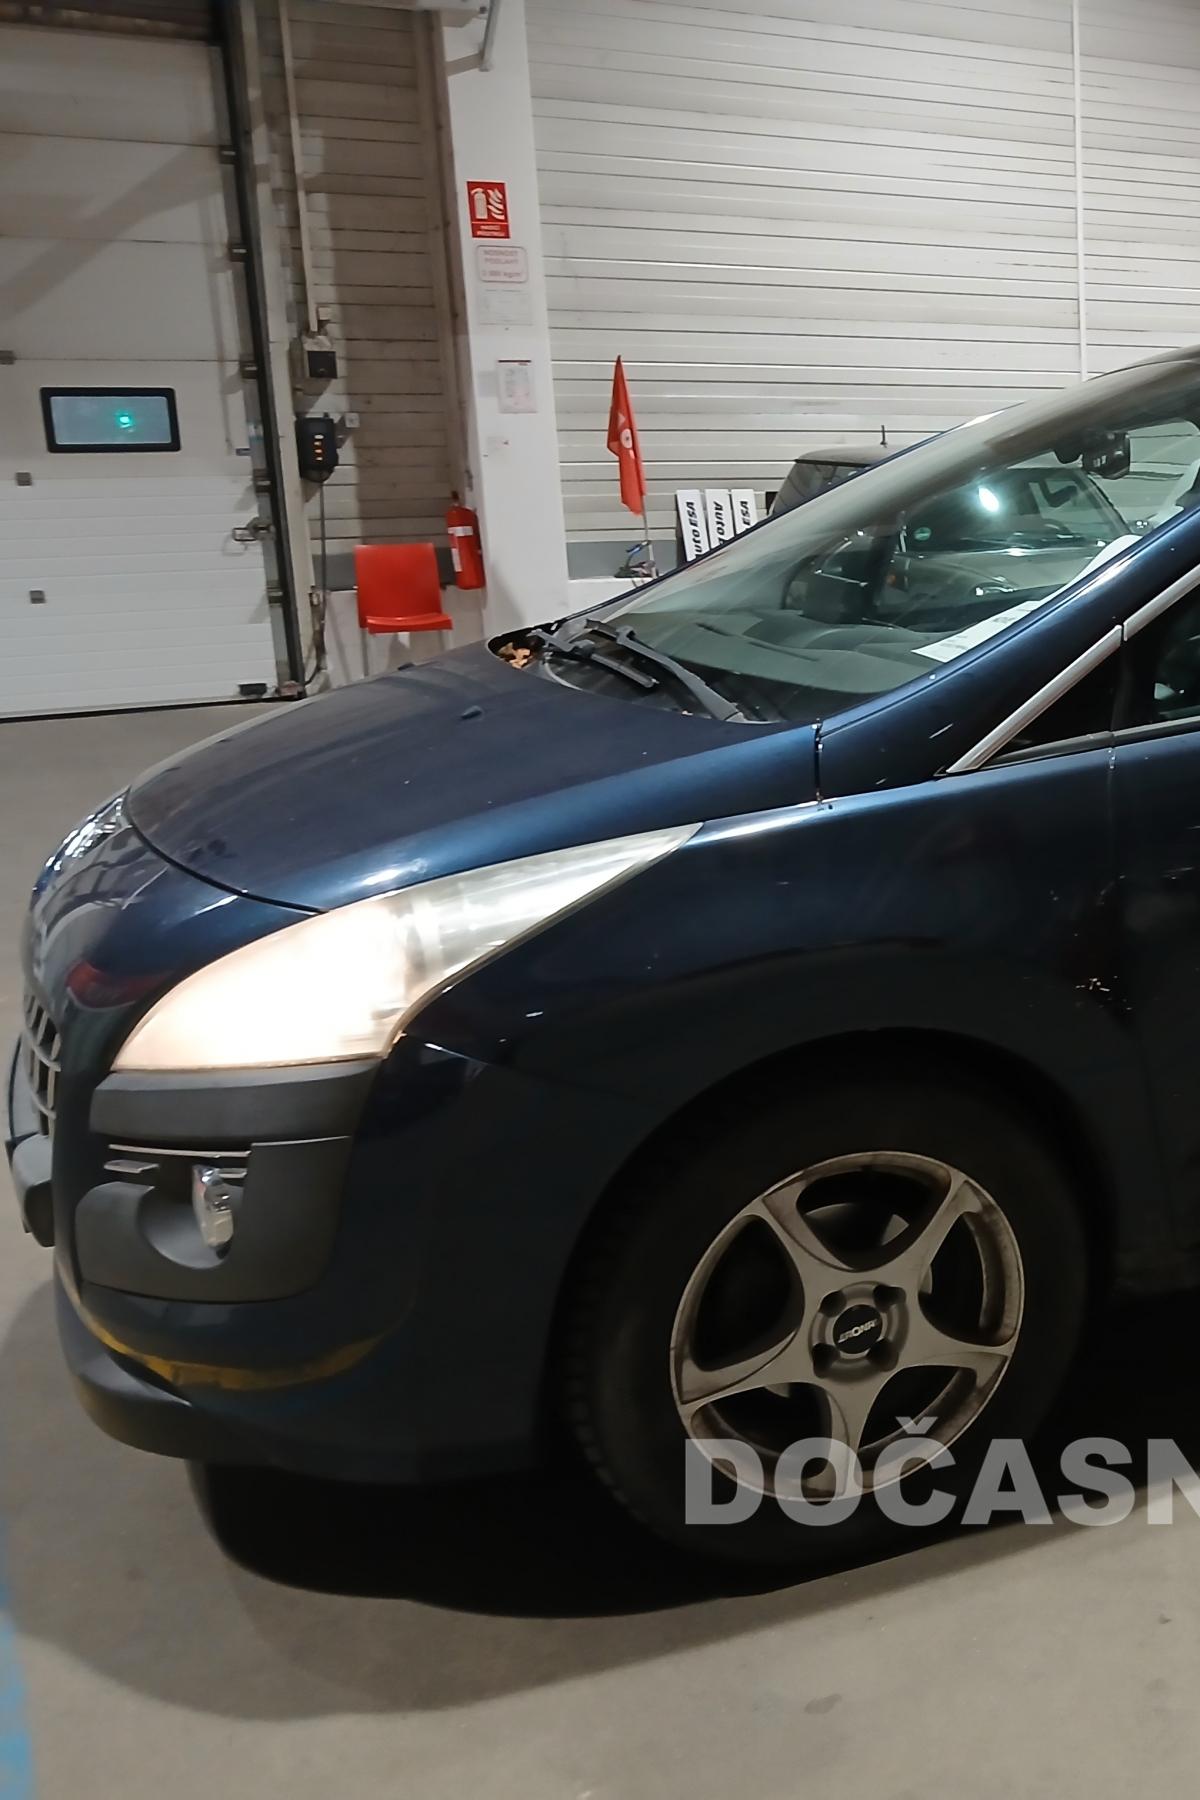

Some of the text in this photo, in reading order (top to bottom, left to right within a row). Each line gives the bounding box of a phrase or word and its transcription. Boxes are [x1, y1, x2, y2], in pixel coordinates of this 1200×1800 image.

[686, 502, 698, 527] ESA
[713, 501, 726, 536] Auto
[740, 501, 750, 526] ESA
